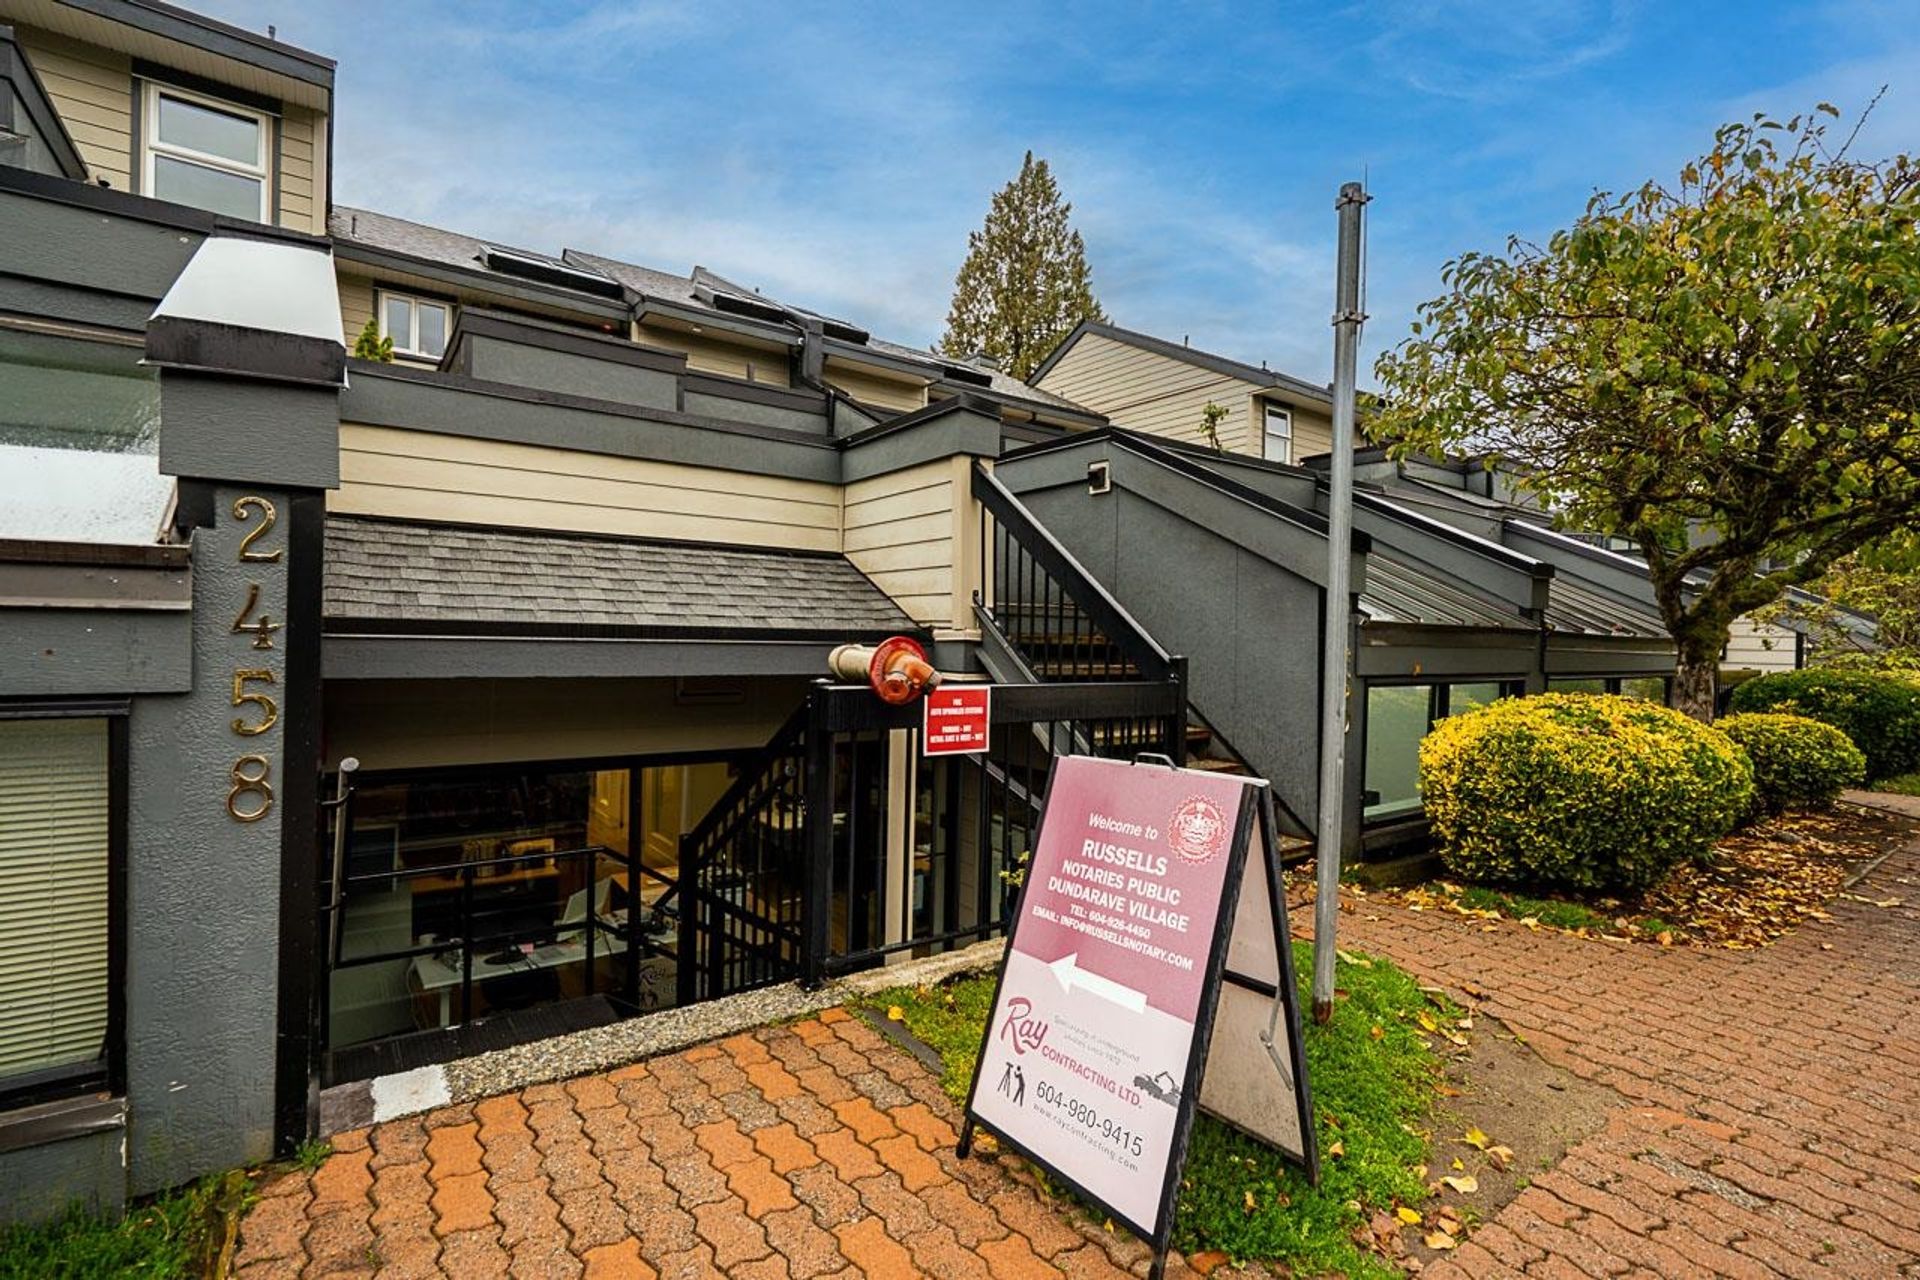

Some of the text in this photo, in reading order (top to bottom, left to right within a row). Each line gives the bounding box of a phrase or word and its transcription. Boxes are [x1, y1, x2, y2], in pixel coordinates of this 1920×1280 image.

[227, 496, 285, 822] 2458
[1088, 812, 1158, 840] Welcome to
[1062, 860, 1181, 905] NOTARIES PUBLIC
[1082, 839, 1168, 876] RUSSELLS
[1048, 876, 1189, 932] DUNDARAVE VILLAGE
[1070, 904, 1088, 918] TEL:
[1032, 905, 1193, 971] EMAIL: INFO@RUSSELLSNOTARY.COM
[1000, 997, 1142, 1109] Ray CONTRACTING LTD.
[1037, 1081, 1143, 1157] 604-980-9415
